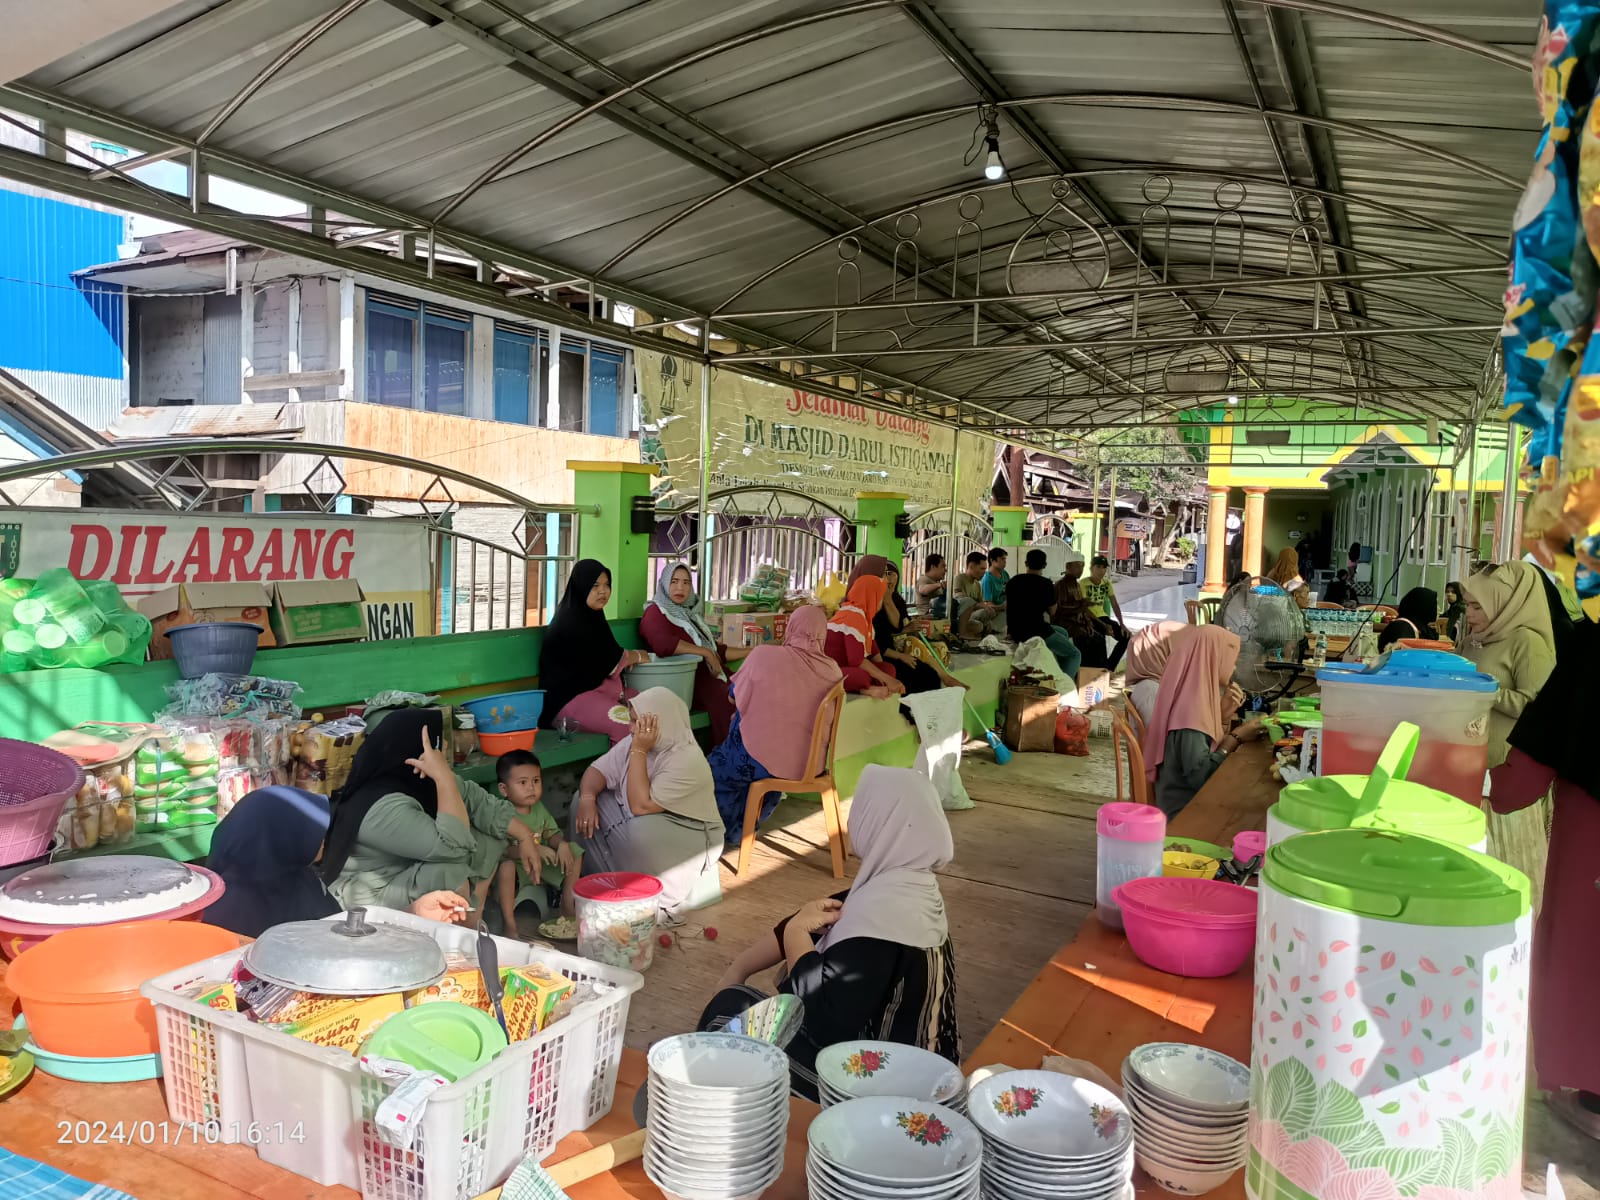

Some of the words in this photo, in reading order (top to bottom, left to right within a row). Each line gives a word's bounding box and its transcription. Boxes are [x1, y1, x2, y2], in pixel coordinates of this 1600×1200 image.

[744, 414, 765, 447] DI
[770, 422, 834, 460] MASJID
[838, 434, 886, 466] DARUL
[67, 524, 355, 584] DILARANG
[365, 602, 415, 641] NGAN
